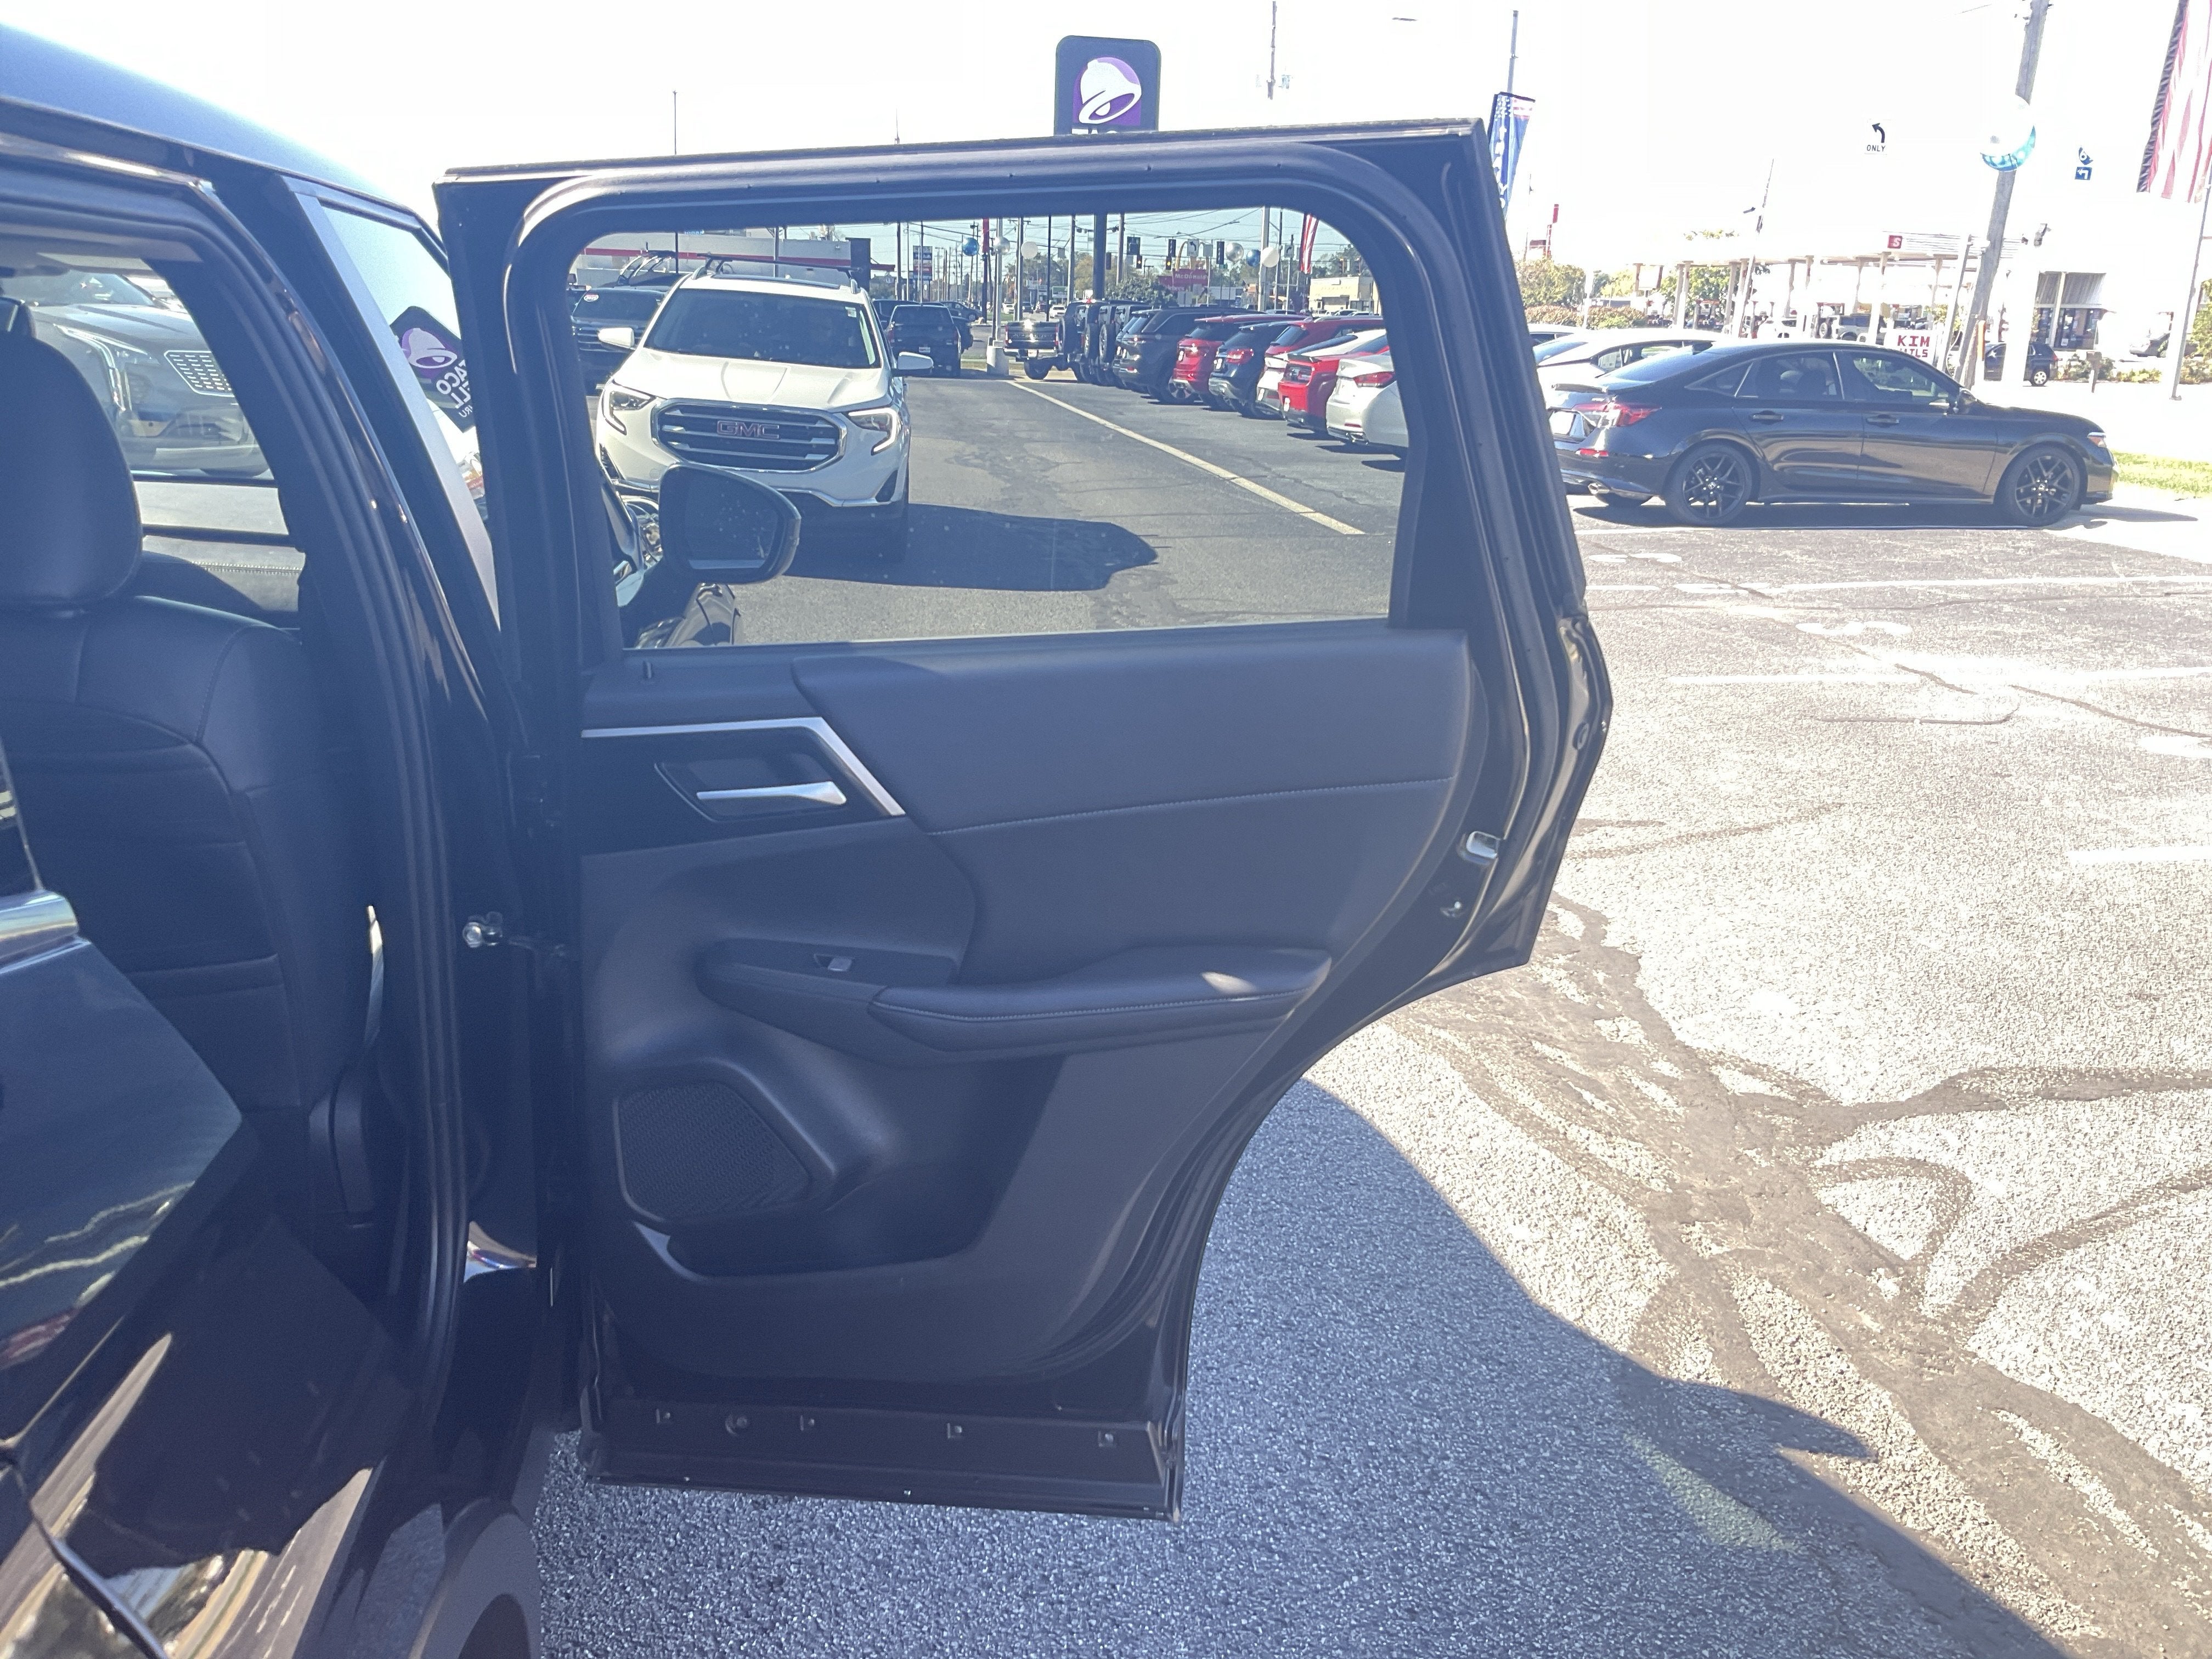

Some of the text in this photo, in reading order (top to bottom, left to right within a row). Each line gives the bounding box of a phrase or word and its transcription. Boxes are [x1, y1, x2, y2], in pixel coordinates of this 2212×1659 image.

[1897, 335, 1930, 347] KIM
[1900, 348, 1928, 358] ILS
[716, 420, 780, 439] GMC
